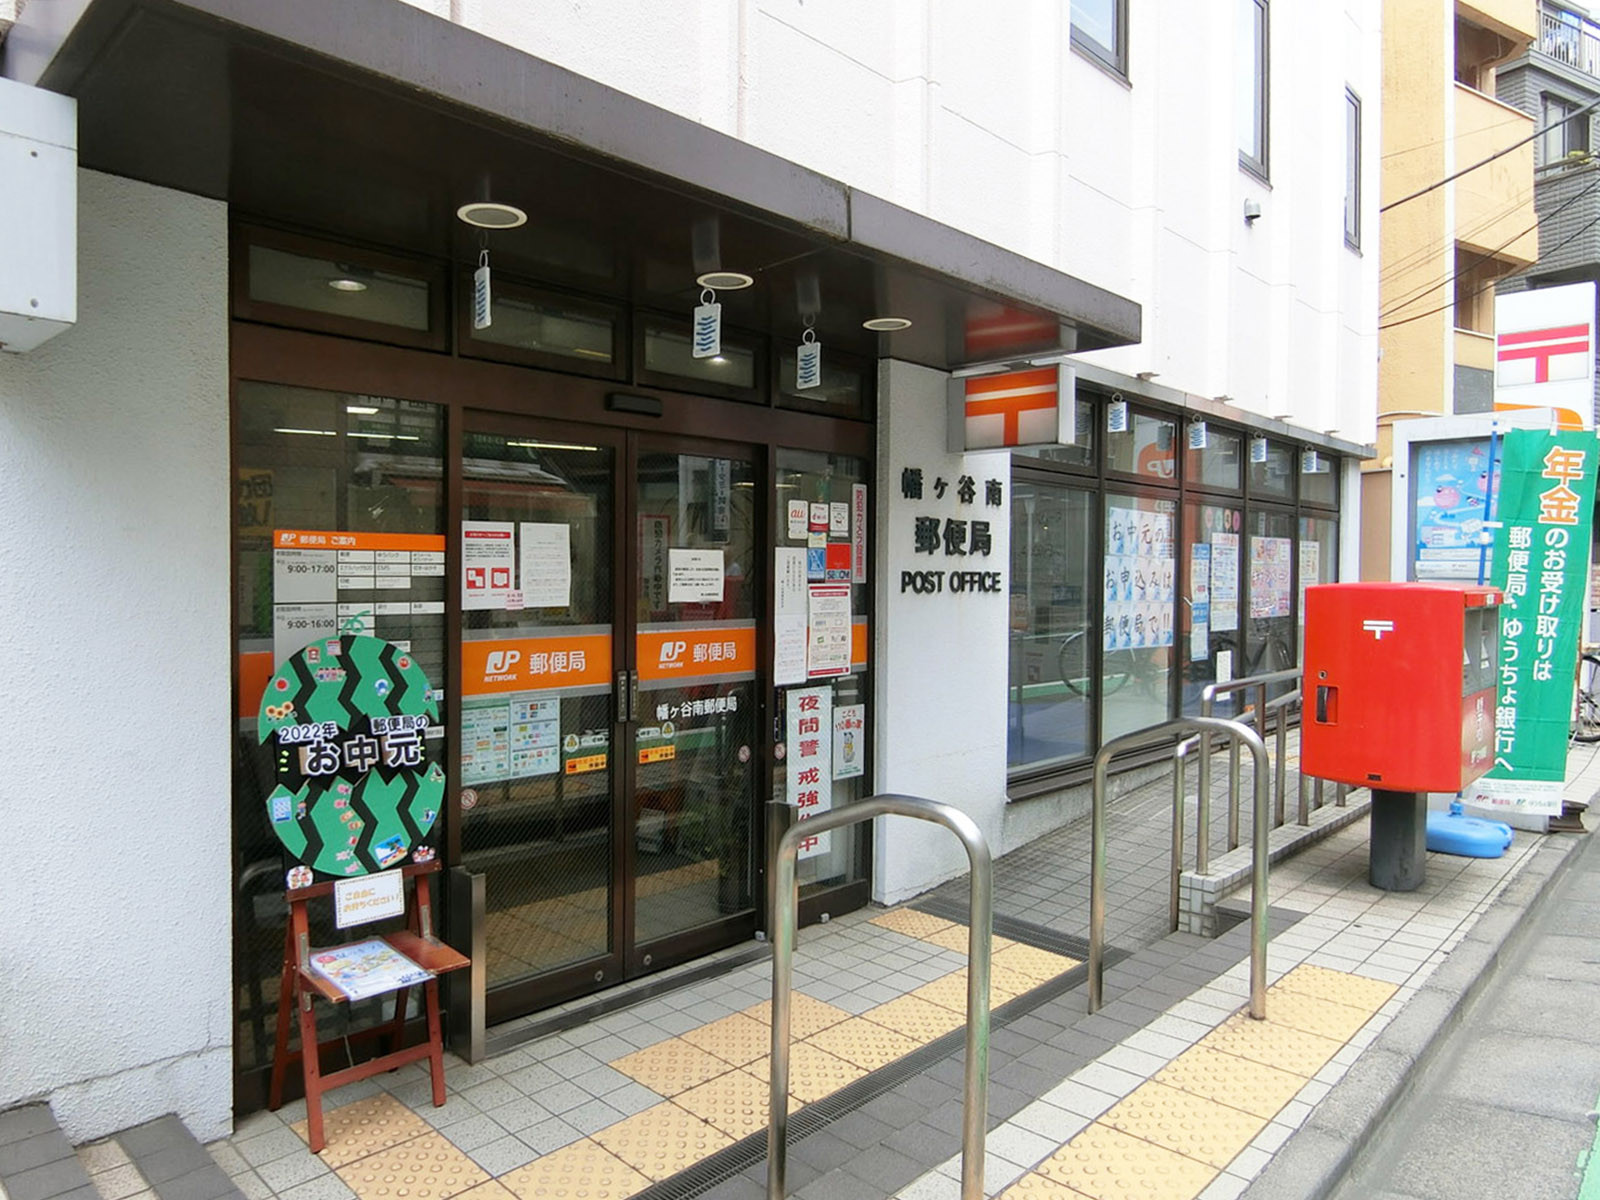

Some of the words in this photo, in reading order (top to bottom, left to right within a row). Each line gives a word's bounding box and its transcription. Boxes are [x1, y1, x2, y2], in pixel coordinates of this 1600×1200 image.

[299, 535, 326, 545] 郵便局
[331, 536, 356, 546] ご案内
[914, 516, 992, 556] 郵便局
[1112, 521, 1165, 546] お中元の
[287, 564, 335, 574] 9:00-17:00
[1533, 446, 1586, 681] 年金のお受け取りは
[901, 571, 945, 593] POST
[949, 571, 1002, 593] OFFICE
[1105, 567, 1173, 591] お申込みは
[287, 619, 335, 629] 9:00-16:00
[529, 650, 586, 675] 郵便局
[693, 641, 737, 663] 郵便局
[280, 722, 339, 743] 2022年
[372, 716, 429, 734] 郵便局の
[306, 732, 422, 776] お中元
[797, 695, 820, 852] 夜間警戒強中
